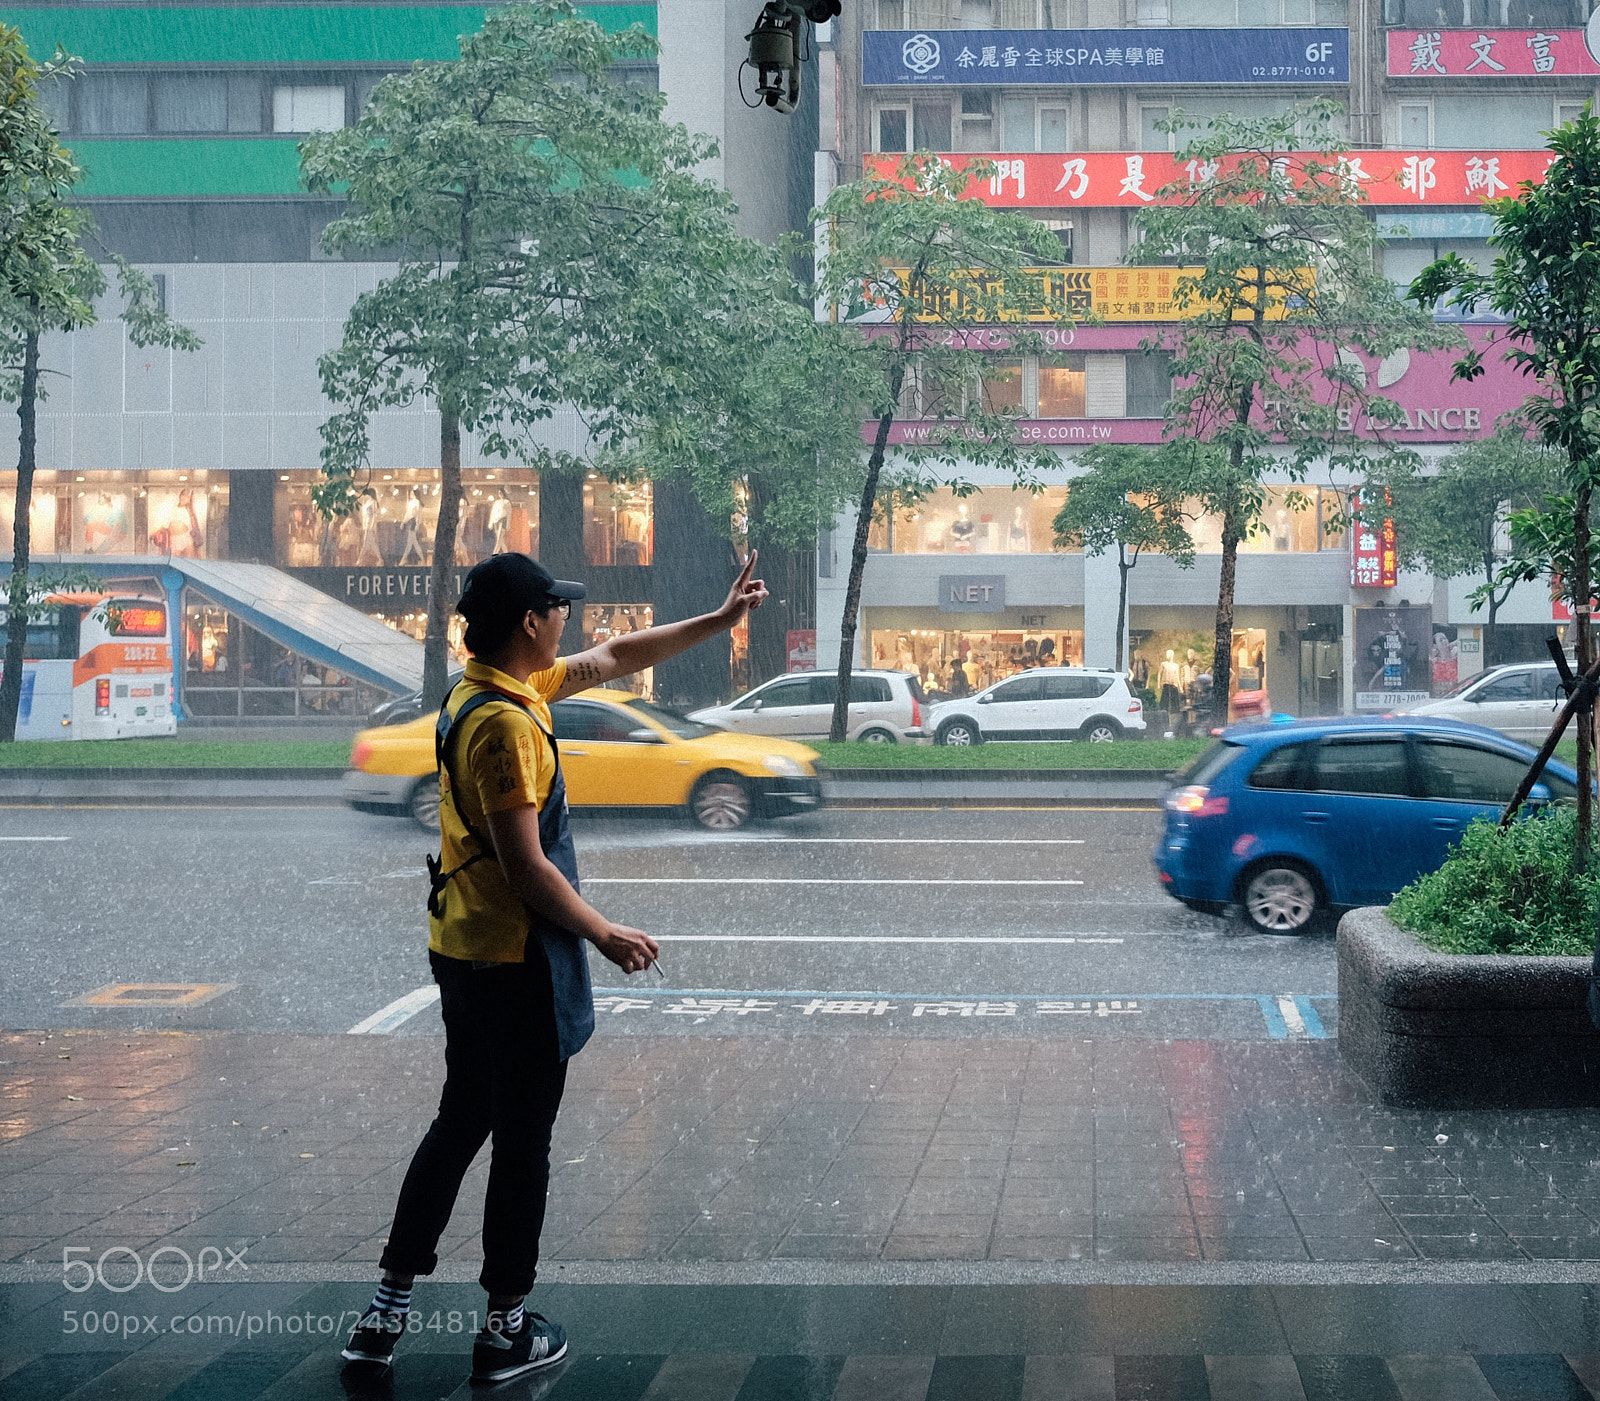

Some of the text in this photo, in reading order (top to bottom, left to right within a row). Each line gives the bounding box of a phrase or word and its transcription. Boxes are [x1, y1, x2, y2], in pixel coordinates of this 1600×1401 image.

[955, 45, 1165, 69] 余麗雪全球SPA美學館
[1305, 42, 1334, 63] 6F
[1409, 32, 1560, 75] 戴文富
[1252, 66, 1336, 77] 02.8771-0104
[1095, 272, 1170, 285] 原廠授權
[1096, 301, 1170, 315] 語文補習班
[941, 329, 1075, 346] 2778-00
[1356, 570, 1379, 584] 12F
[950, 584, 994, 603] NET
[1021, 615, 1047, 626] NET
